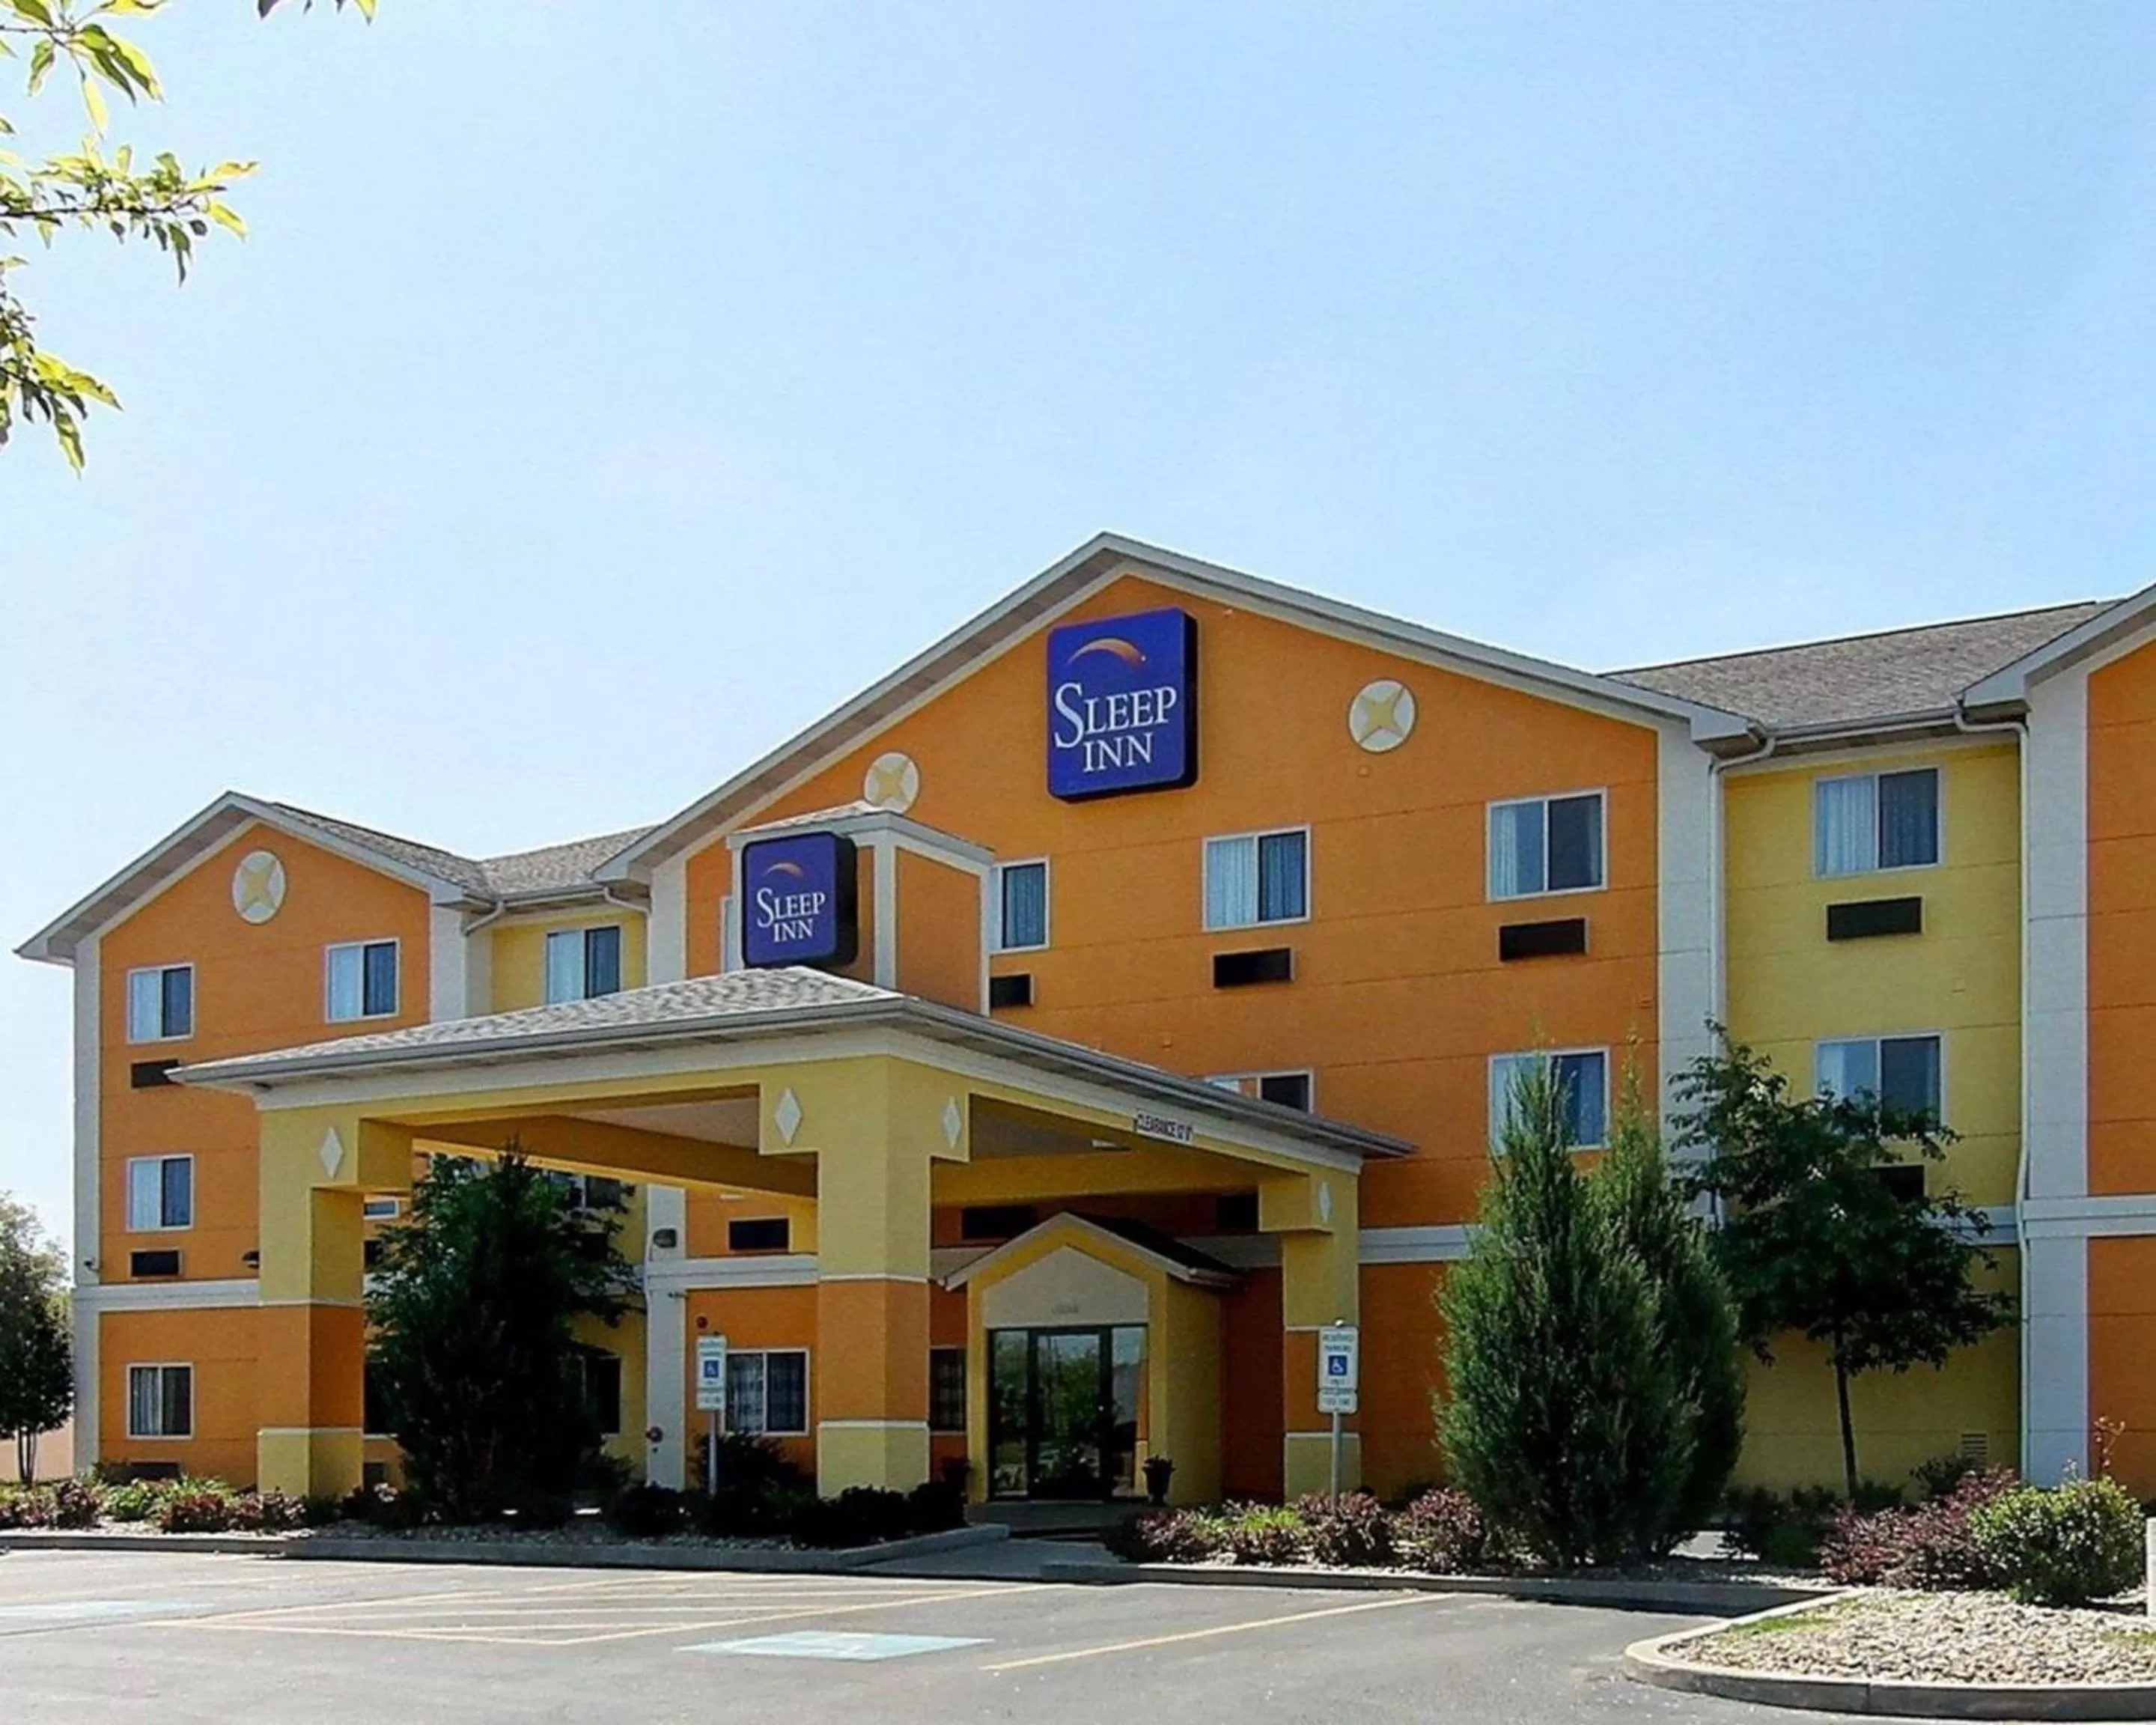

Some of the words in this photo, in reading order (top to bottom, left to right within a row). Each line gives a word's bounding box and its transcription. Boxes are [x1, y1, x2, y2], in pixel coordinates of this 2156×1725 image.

[1054, 682, 1177, 749] SLEEP
[1082, 731, 1154, 773] INN
[756, 887, 826, 928] SLEEP
[773, 918, 813, 943] INN
